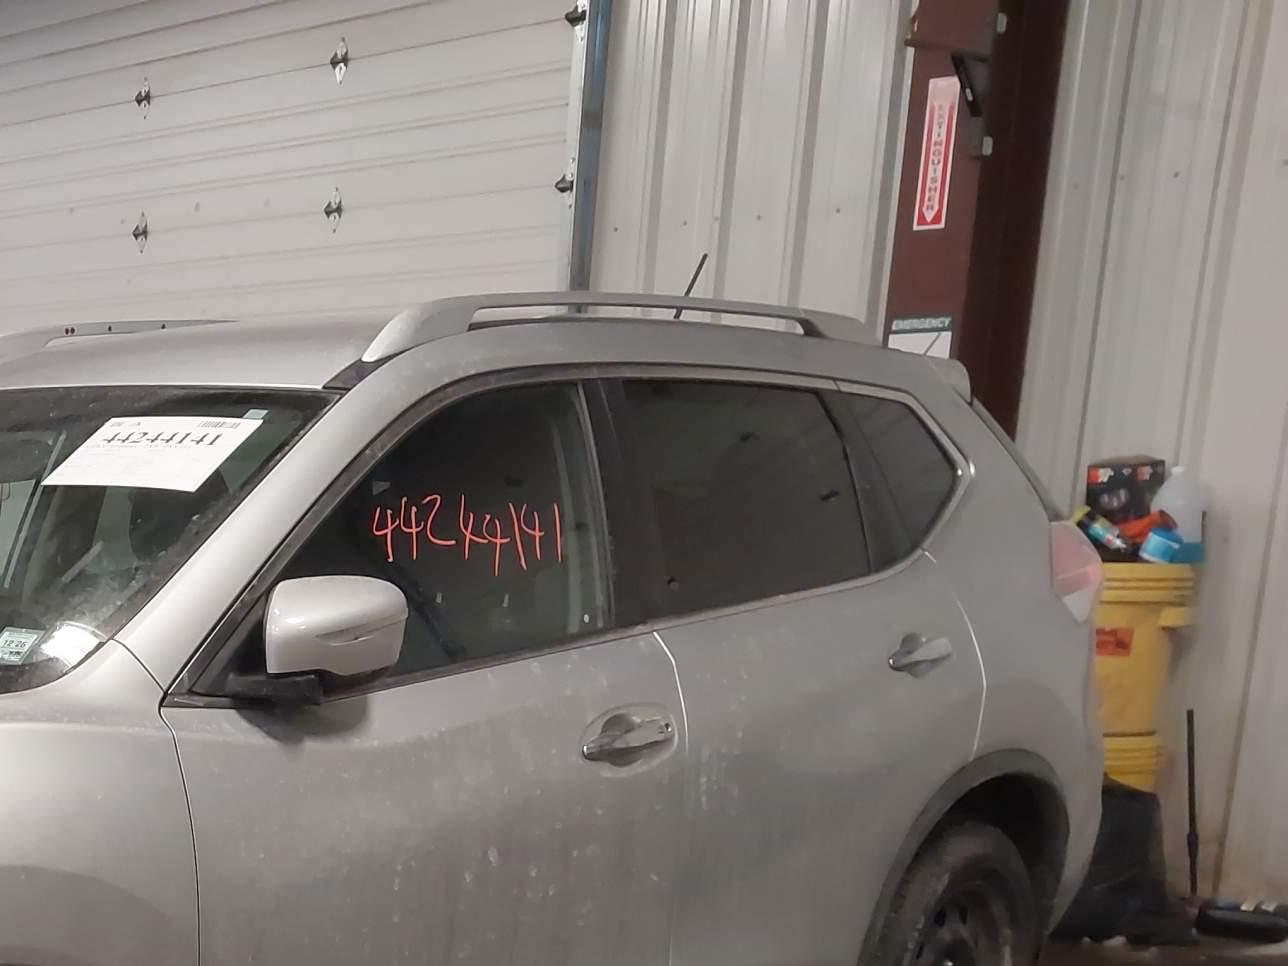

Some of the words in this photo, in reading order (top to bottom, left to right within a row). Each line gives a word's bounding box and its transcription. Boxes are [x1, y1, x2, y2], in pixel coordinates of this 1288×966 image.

[925, 103, 944, 212] EXTINGUISHER
[892, 316, 952, 331] EMERGENCY
[101, 430, 224, 447] 44244141
[371, 493, 563, 578] 44244141
